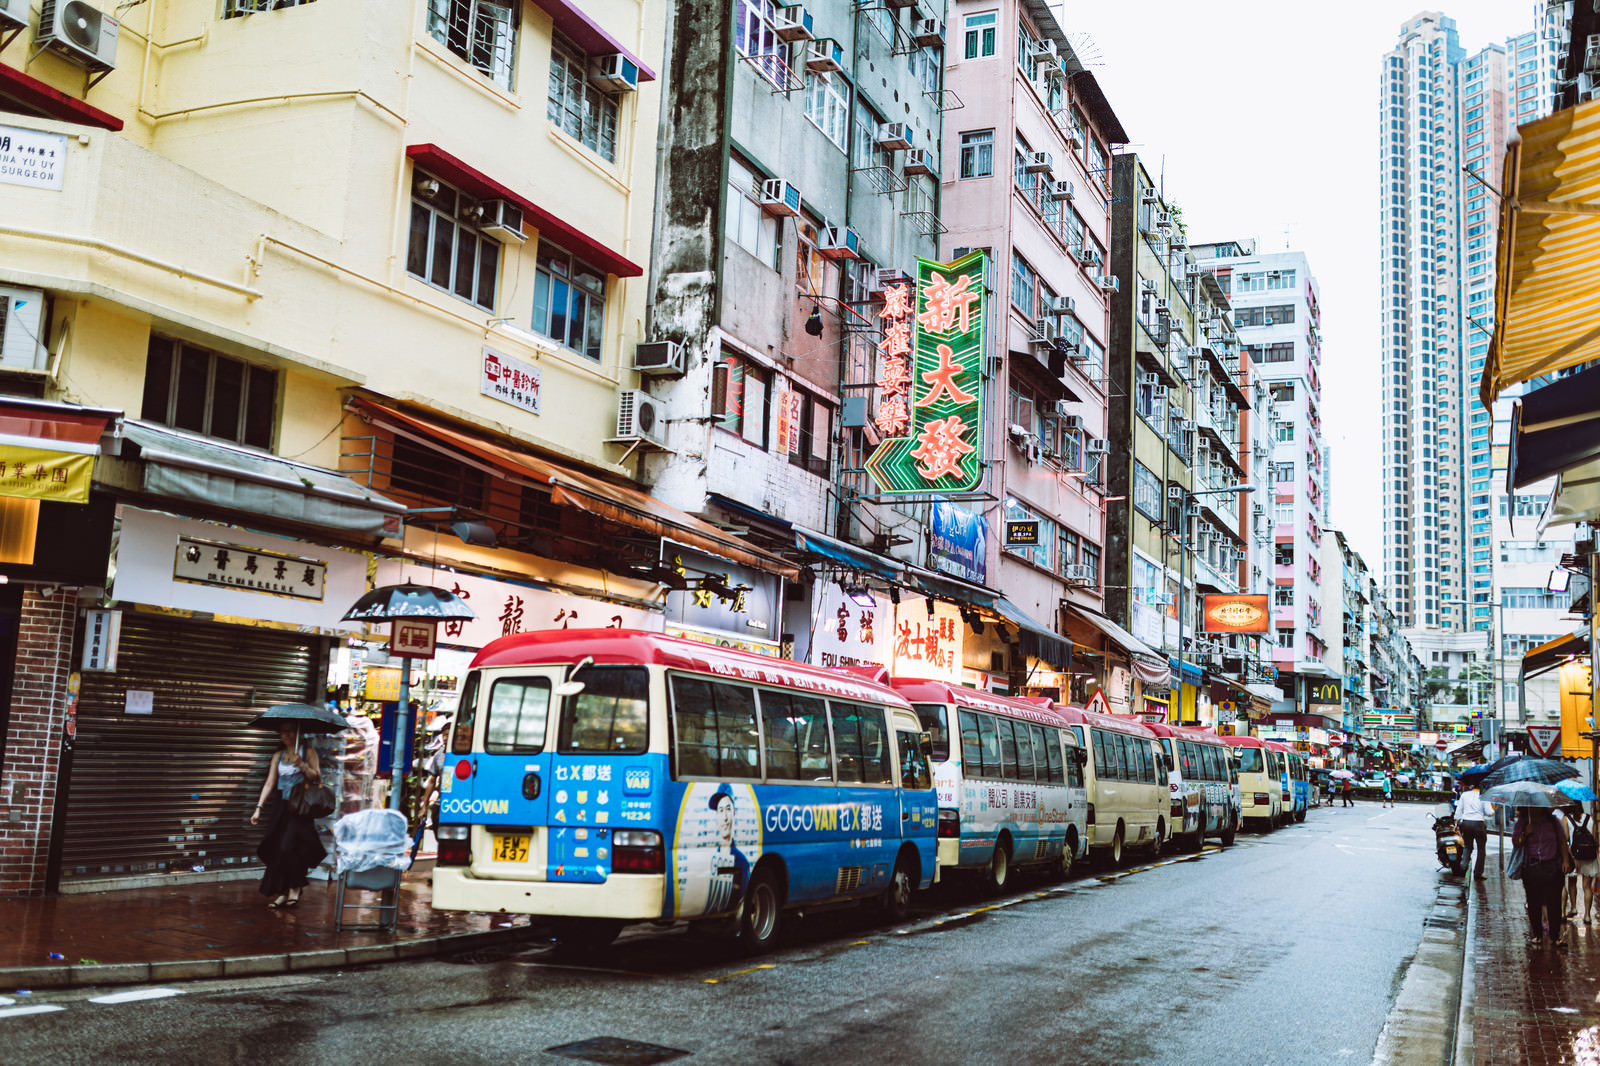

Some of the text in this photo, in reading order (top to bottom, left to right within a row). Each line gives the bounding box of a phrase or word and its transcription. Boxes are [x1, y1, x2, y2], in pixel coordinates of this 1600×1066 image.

[23, 157, 36, 167] YU
[41, 160, 54, 169] UY
[1, 165, 54, 181] SURGEON
[875, 283, 912, 435] 麻雀耍樂
[502, 365, 540, 396] 中醫診所
[910, 271, 979, 480] 新大發
[896, 619, 939, 667] 波士頓
[821, 652, 838, 667] FOU
[938, 648, 955, 675] 公司
[626, 770, 649, 778] GOGO
[626, 778, 650, 789] VAN
[440, 799, 508, 814] GOGOVAN
[495, 849, 527, 860] 1437
